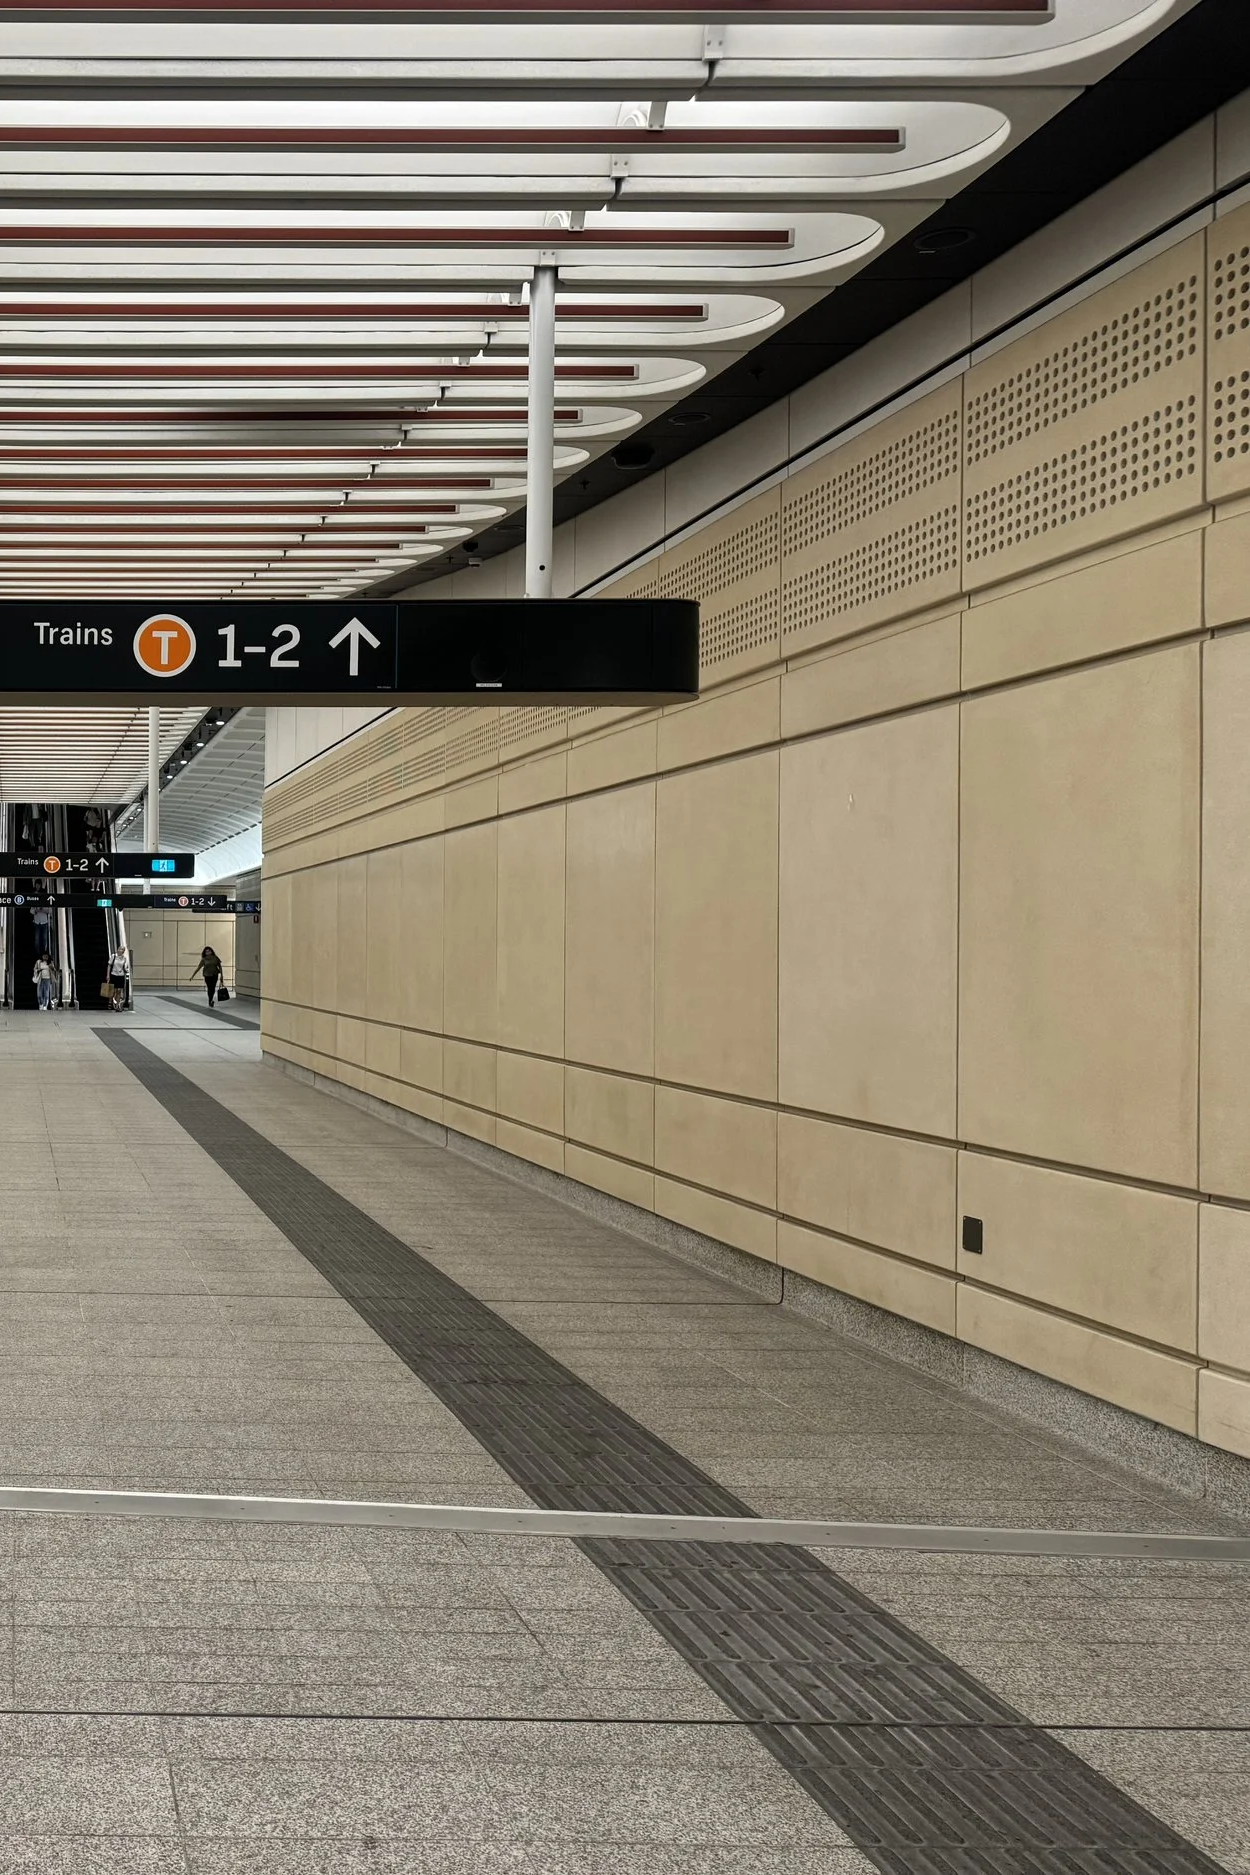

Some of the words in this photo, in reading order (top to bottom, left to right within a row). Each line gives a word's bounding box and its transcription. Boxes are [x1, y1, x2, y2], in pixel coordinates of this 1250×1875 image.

[33, 622, 113, 645] Trains
[152, 631, 179, 665] T
[17, 857, 39, 865] Trains
